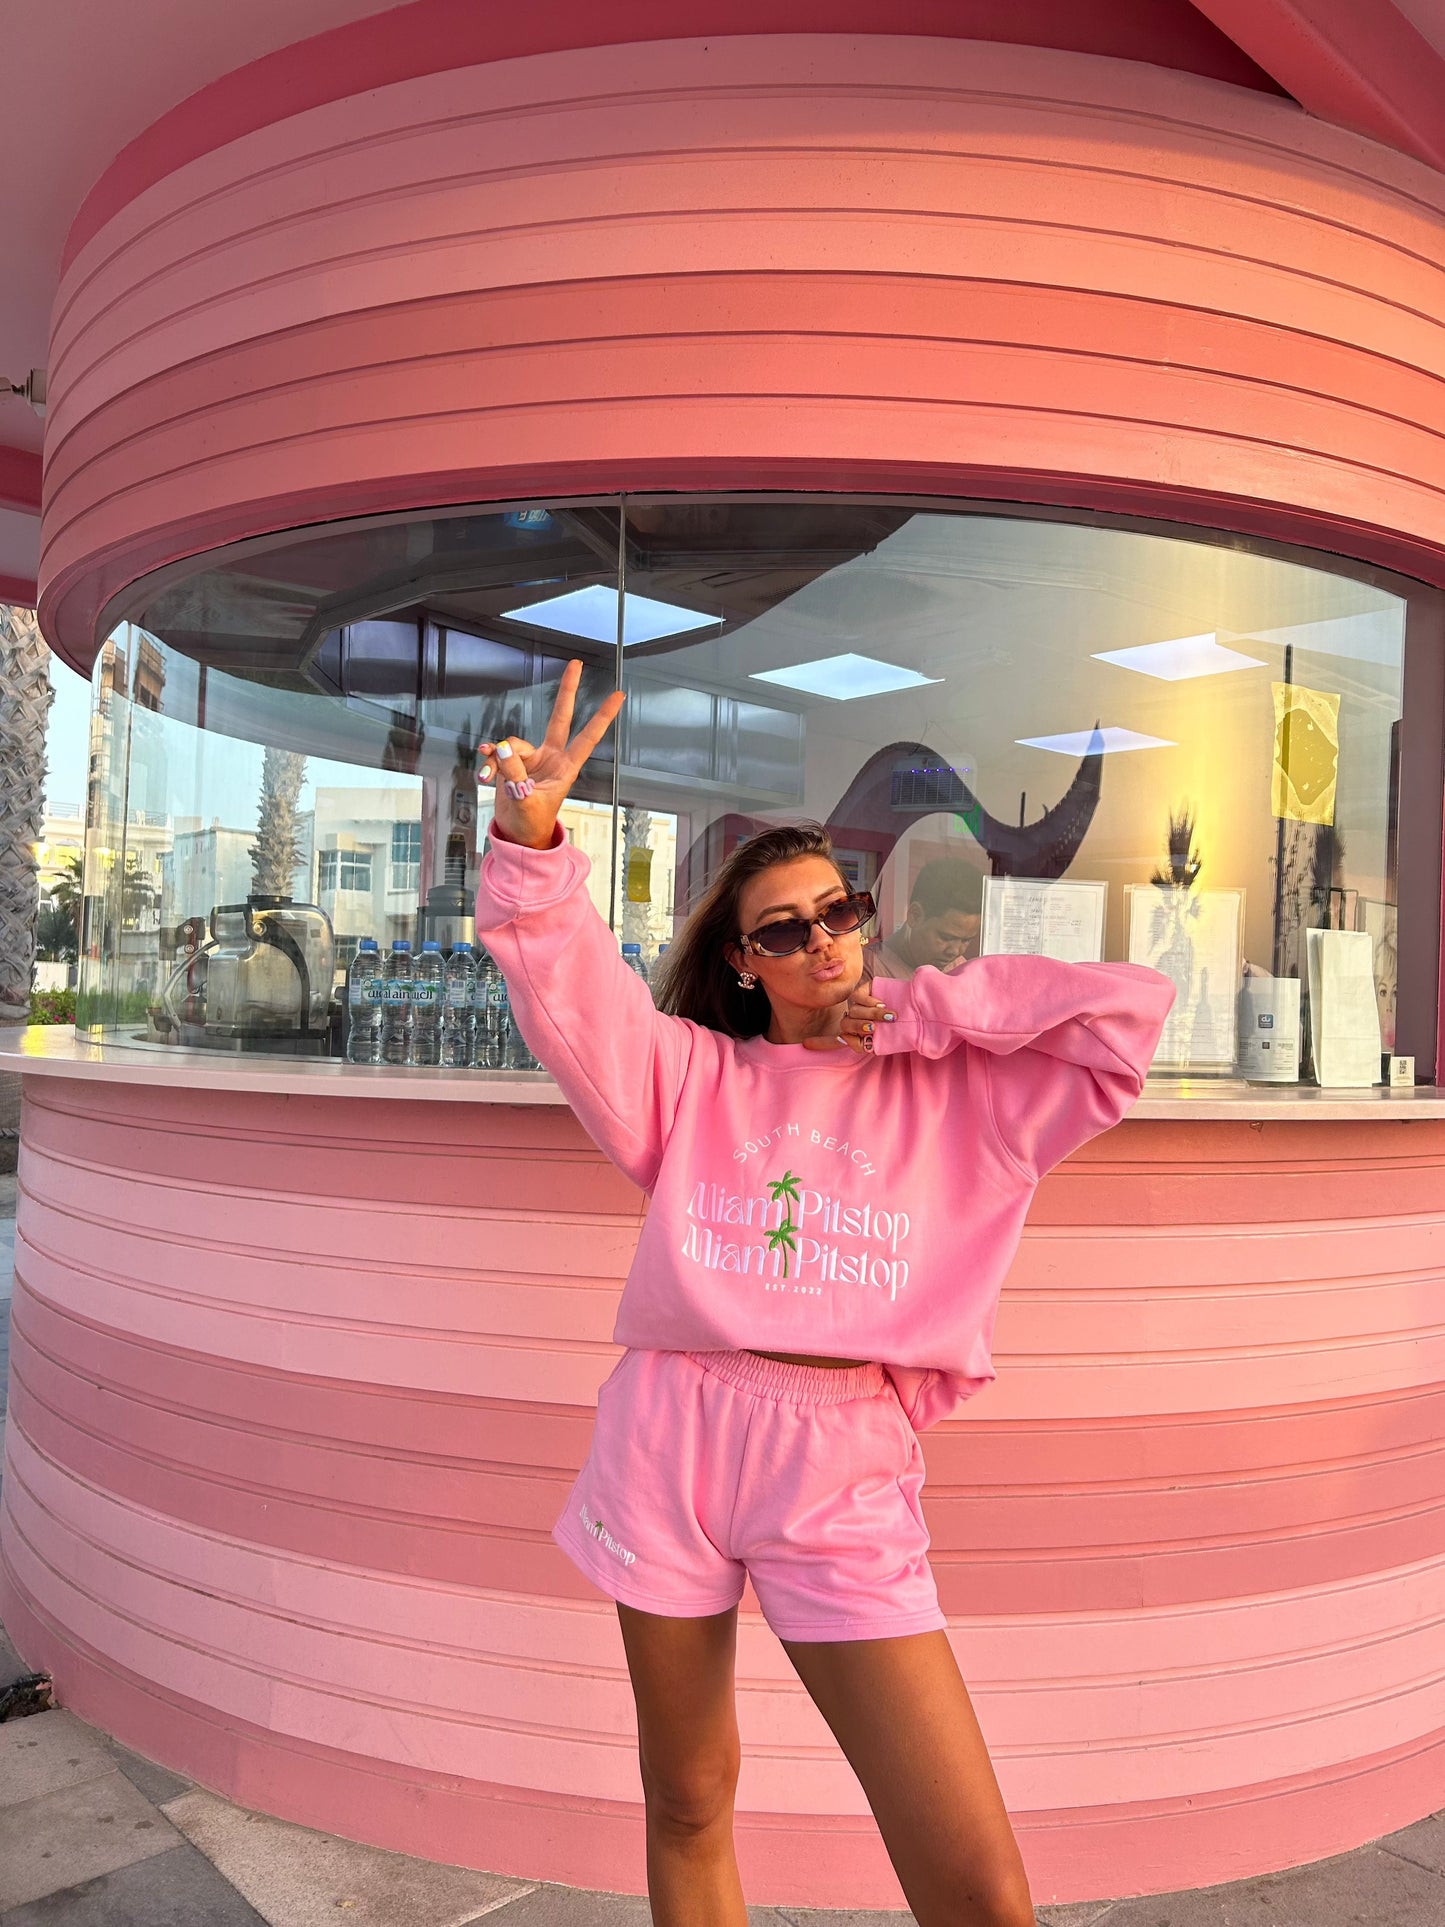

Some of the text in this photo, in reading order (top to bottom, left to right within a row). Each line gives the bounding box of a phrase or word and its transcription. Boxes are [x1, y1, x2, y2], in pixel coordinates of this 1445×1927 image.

[733, 1122, 876, 1176] SOUTH BEACH
[797, 1189, 910, 1254] Pitstop
[794, 1237, 909, 1302] Pitstop
[598, 1527, 636, 1566] Pitstop
